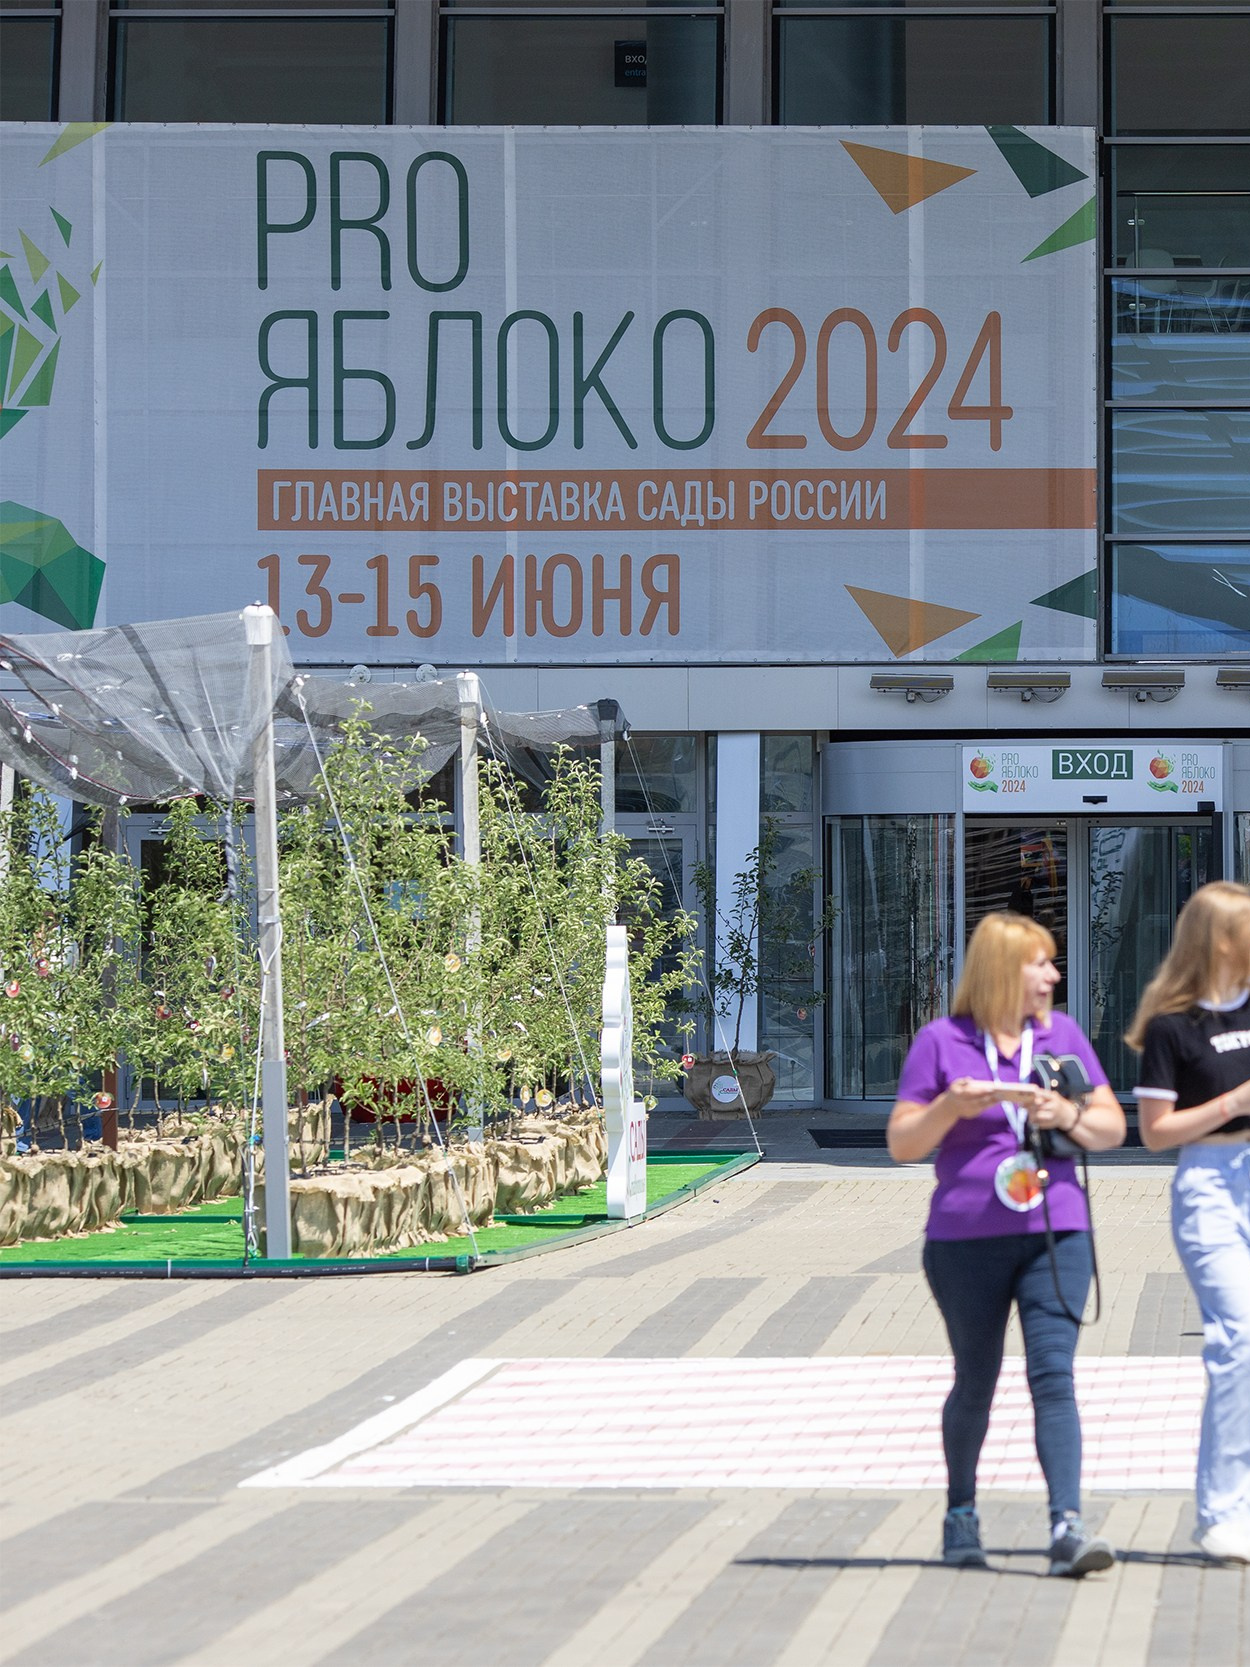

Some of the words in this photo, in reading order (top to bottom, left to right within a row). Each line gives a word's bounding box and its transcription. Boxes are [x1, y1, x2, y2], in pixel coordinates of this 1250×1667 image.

[624, 55, 647, 64] ВХО
[257, 150, 470, 293] PRO
[257, 309, 716, 452] ЯБЛОКО
[746, 307, 1014, 452] 2024
[272, 480, 430, 522] ГЛАВНАЯ
[443, 480, 626, 522] ВЫСТАВКА
[637, 480, 736, 527] САДЫ
[748, 479, 887, 521] РОССИИ
[257, 554, 443, 638] 13-15
[472, 554, 681, 638] ИЮНЯ
[1001, 752, 1020, 765] PRO
[1181, 753, 1199, 766] PRO
[1001, 765, 1039, 778] ЯБЛОКО
[1058, 753, 1128, 778] ВХОД
[1181, 766, 1216, 779] ЯБЛОКО
[1001, 779, 1026, 792] 2024
[1181, 780, 1205, 793] 2024
